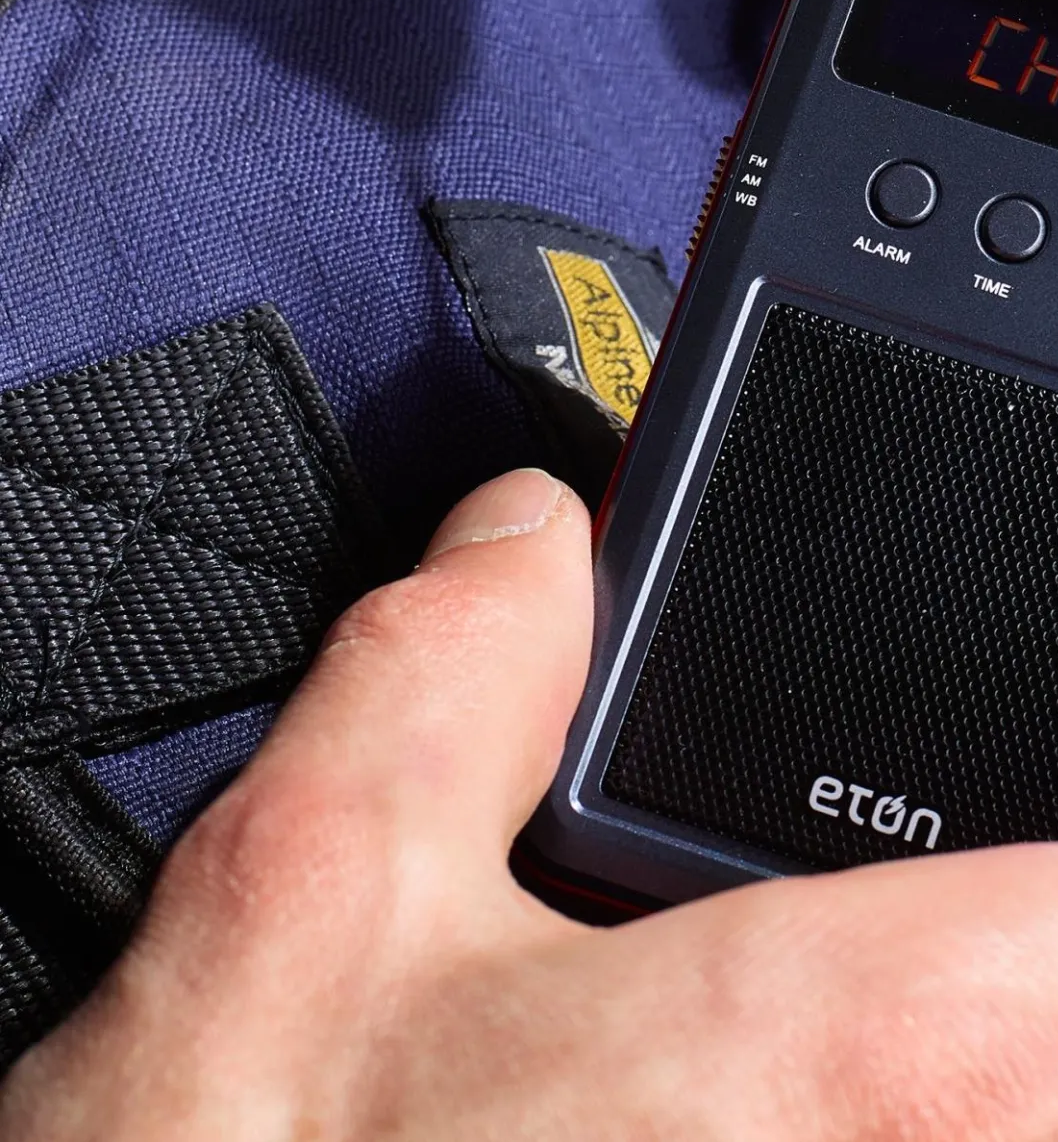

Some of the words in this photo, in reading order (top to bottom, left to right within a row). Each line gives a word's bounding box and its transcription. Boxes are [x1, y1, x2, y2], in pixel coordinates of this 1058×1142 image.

[748, 154, 768, 168] FM
[740, 173, 762, 187] AM
[735, 191, 758, 207] WB
[852, 235, 912, 265] ALARM
[973, 273, 1011, 299] TIME
[573, 275, 642, 408] Alpine
